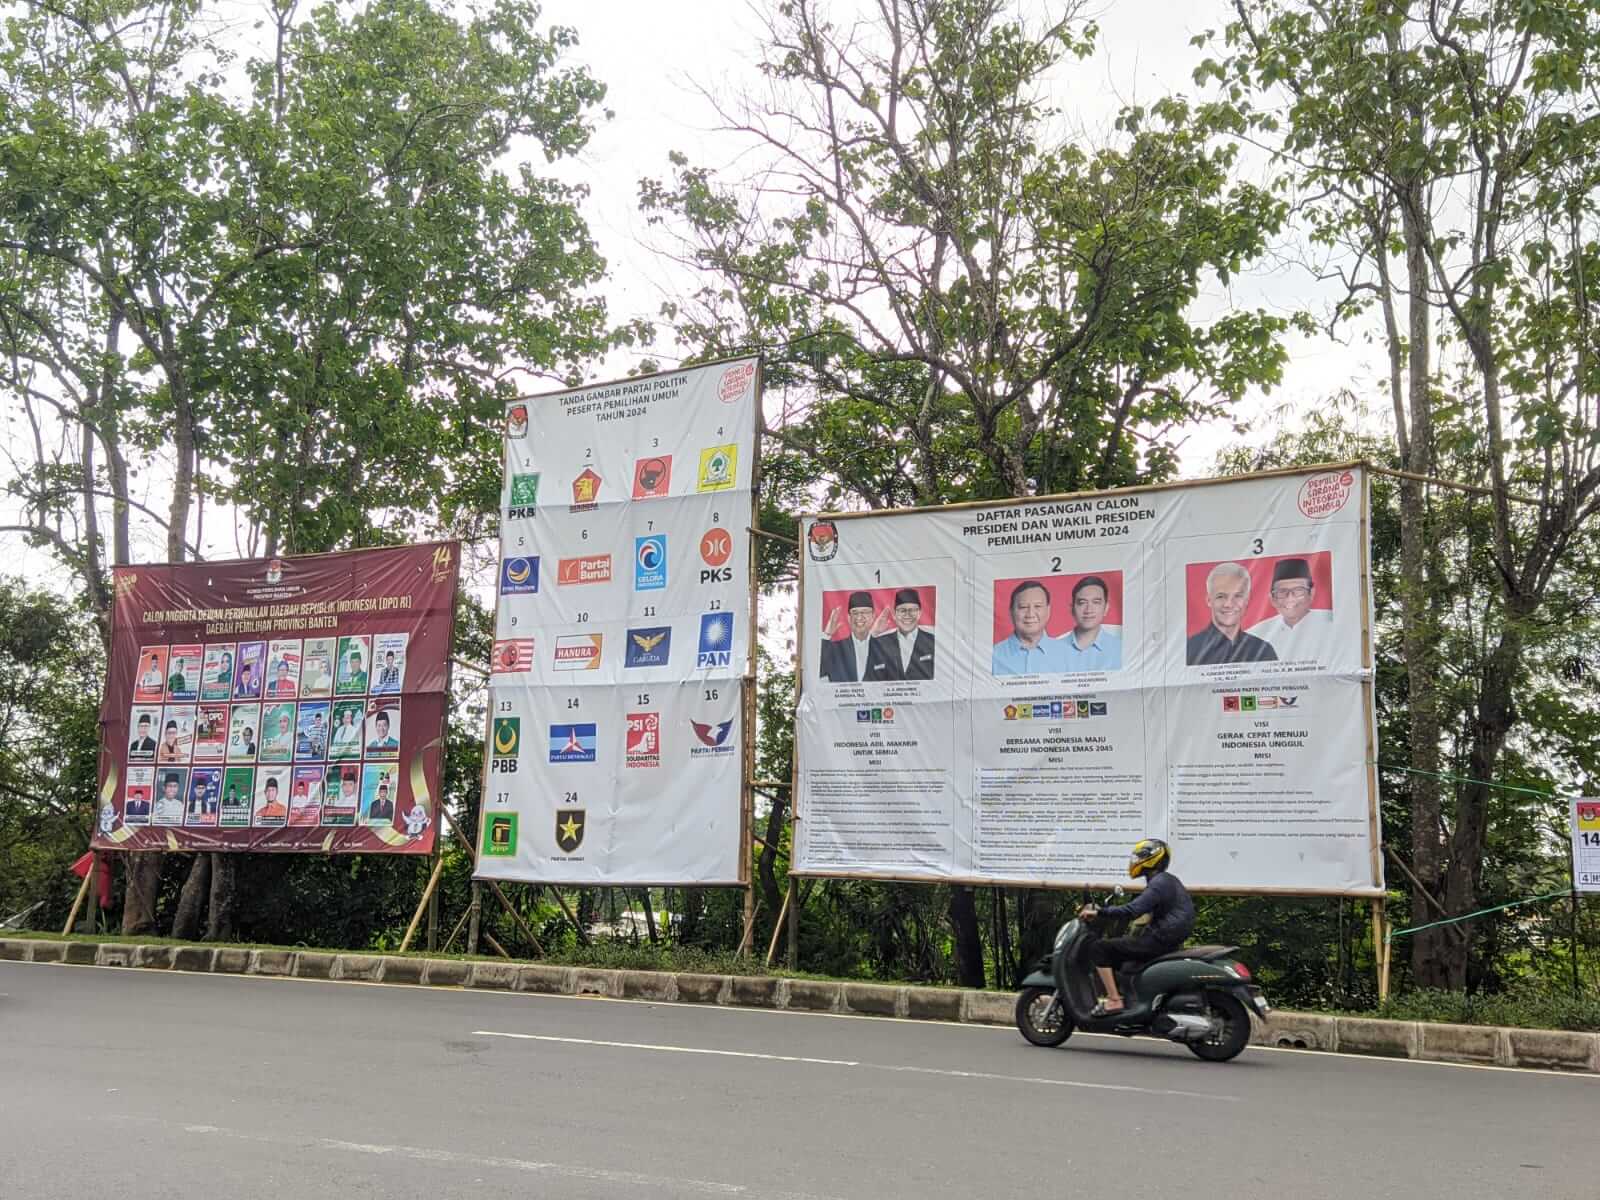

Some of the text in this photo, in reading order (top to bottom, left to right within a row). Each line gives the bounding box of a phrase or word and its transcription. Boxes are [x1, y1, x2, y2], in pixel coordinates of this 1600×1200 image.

[559, 376, 688, 406] TANDA GAMBAR PARTAI POLITIK
[567, 389, 679, 417] PESERTA PEMILIHAN UMUM
[596, 407, 647, 423] TAHUN 2024
[717, 426, 723, 436] 4
[652, 438, 659, 448] 3
[585, 448, 592, 458] 2
[525, 458, 530, 467] 1
[1308, 475, 1339, 488] PEMILU
[508, 508, 535, 519] PKB
[976, 497, 1139, 522] DAFTAR PASANGAN CALON
[713, 512, 719, 522] 8
[963, 509, 1155, 536] PRESIDEN DAN WAKIL PRESIDEN
[648, 521, 653, 531] 7
[582, 529, 588, 539] 6
[987, 525, 1129, 547] PEMILIHAN UMUM 2024
[518, 537, 524, 546] 5
[1252, 538, 1264, 555] 3
[581, 558, 609, 570] Partai
[1051, 557, 1062, 572] 2
[581, 569, 609, 580] Buruh
[700, 568, 732, 584] PKS
[874, 569, 881, 584] 1
[143, 611, 164, 622] CALON
[166, 609, 197, 621] ANGGOTA
[199, 608, 223, 620] DEWAN
[224, 605, 268, 619] PERWAKILAN
[270, 605, 299, 617] DAERAH
[300, 602, 336, 615] REPUBLIK
[337, 599, 377, 612] INDONESIA
[710, 600, 721, 610] 12
[643, 606, 655, 616] 11
[511, 617, 518, 626] 9
[577, 612, 589, 623] 10
[206, 616, 338, 635] DAERAH PEMILIHAN PROVINSI BANTEN
[558, 648, 592, 657] HANURA
[697, 652, 730, 667] PAN
[638, 694, 650, 705] 15
[705, 689, 719, 701] 16
[500, 701, 512, 711] 13
[567, 698, 579, 709] 14
[627, 720, 643, 731] PSI
[491, 760, 518, 774] PBB
[497, 793, 509, 803] 17
[565, 792, 578, 802] 24
[1581, 832, 1600, 846] 14
